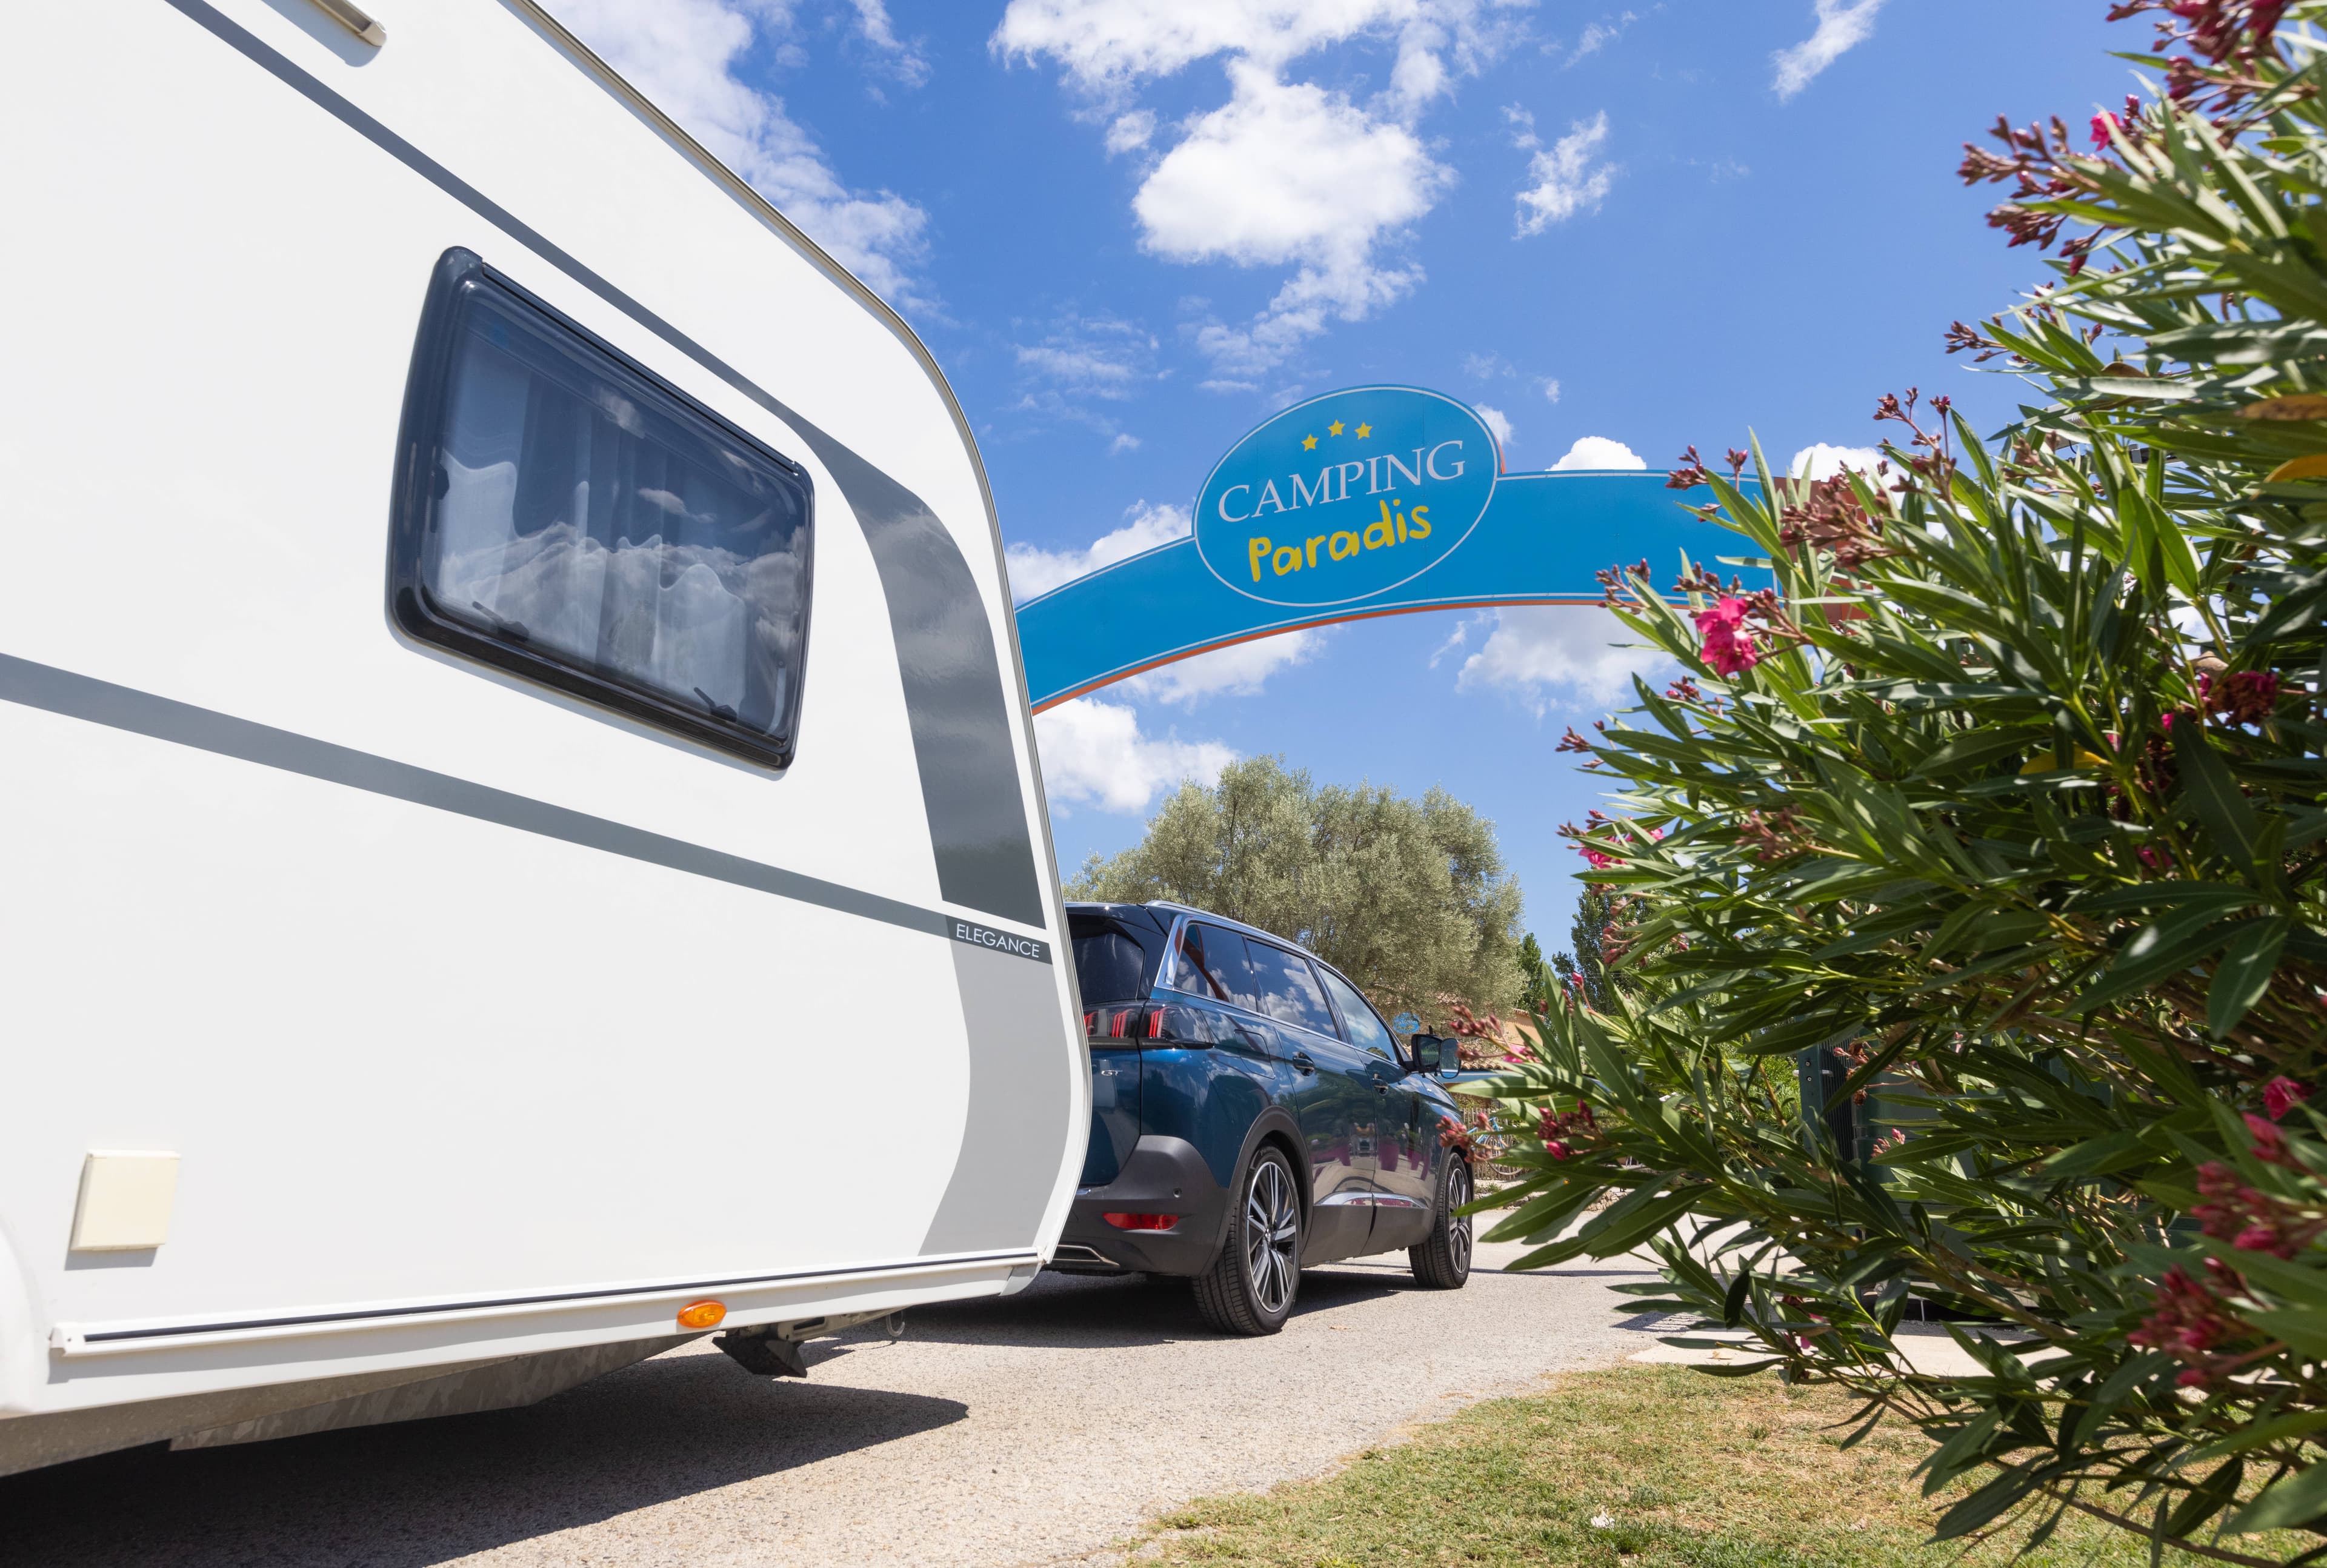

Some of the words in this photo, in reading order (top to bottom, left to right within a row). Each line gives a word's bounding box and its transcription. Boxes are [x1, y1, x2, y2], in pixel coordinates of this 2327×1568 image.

[1218, 440, 1465, 523] CAMPING
[1248, 499, 1431, 582] Paradis
[956, 923, 1040, 958] ELEGANCE
